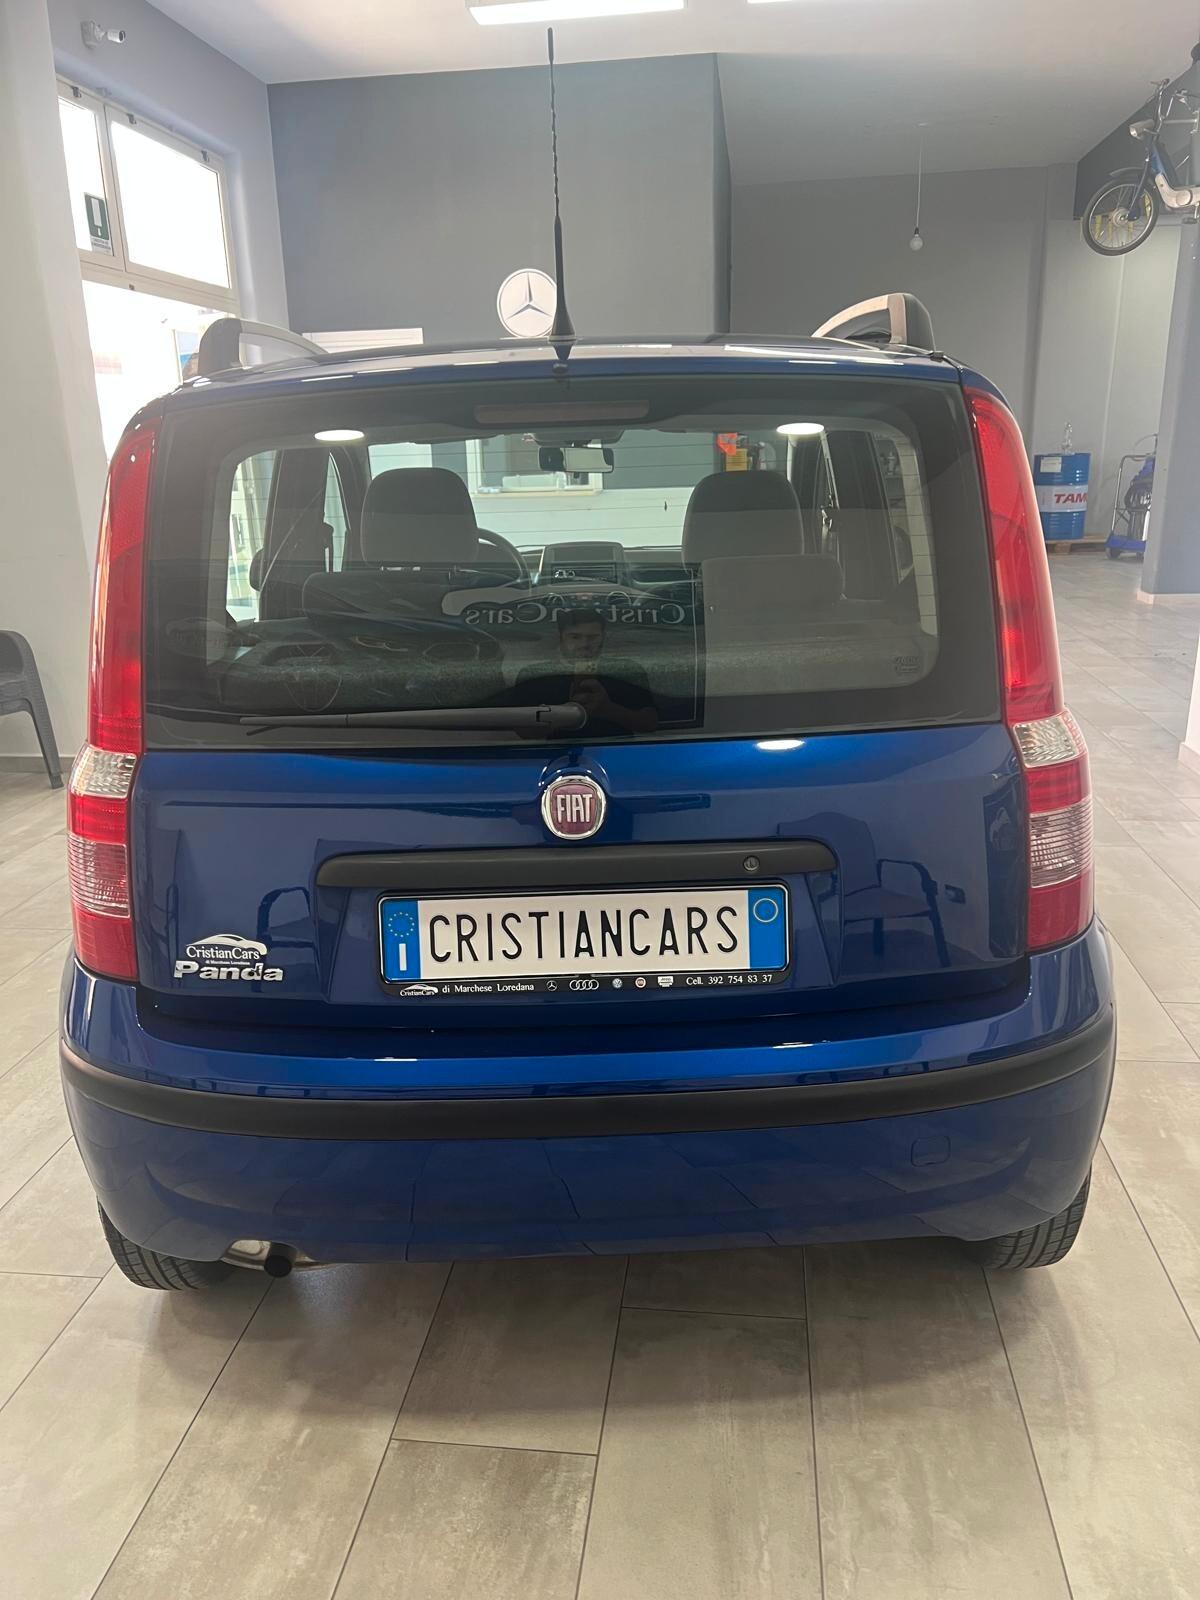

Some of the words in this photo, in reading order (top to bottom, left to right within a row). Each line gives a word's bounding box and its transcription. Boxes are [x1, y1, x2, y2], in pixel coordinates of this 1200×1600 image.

[556, 793, 593, 823] FIAT
[428, 905, 738, 963] CRISTIANCARS
[185, 945, 260, 960] CristianCars
[173, 960, 284, 981] Panda
[707, 976, 724, 985] 392
[727, 975, 743, 984] 754
[747, 974, 758, 983] 83
[762, 974, 773, 983] 37
[441, 984, 450, 993] di
[454, 984, 493, 993] Marchese
[496, 982, 535, 992] Loredana
